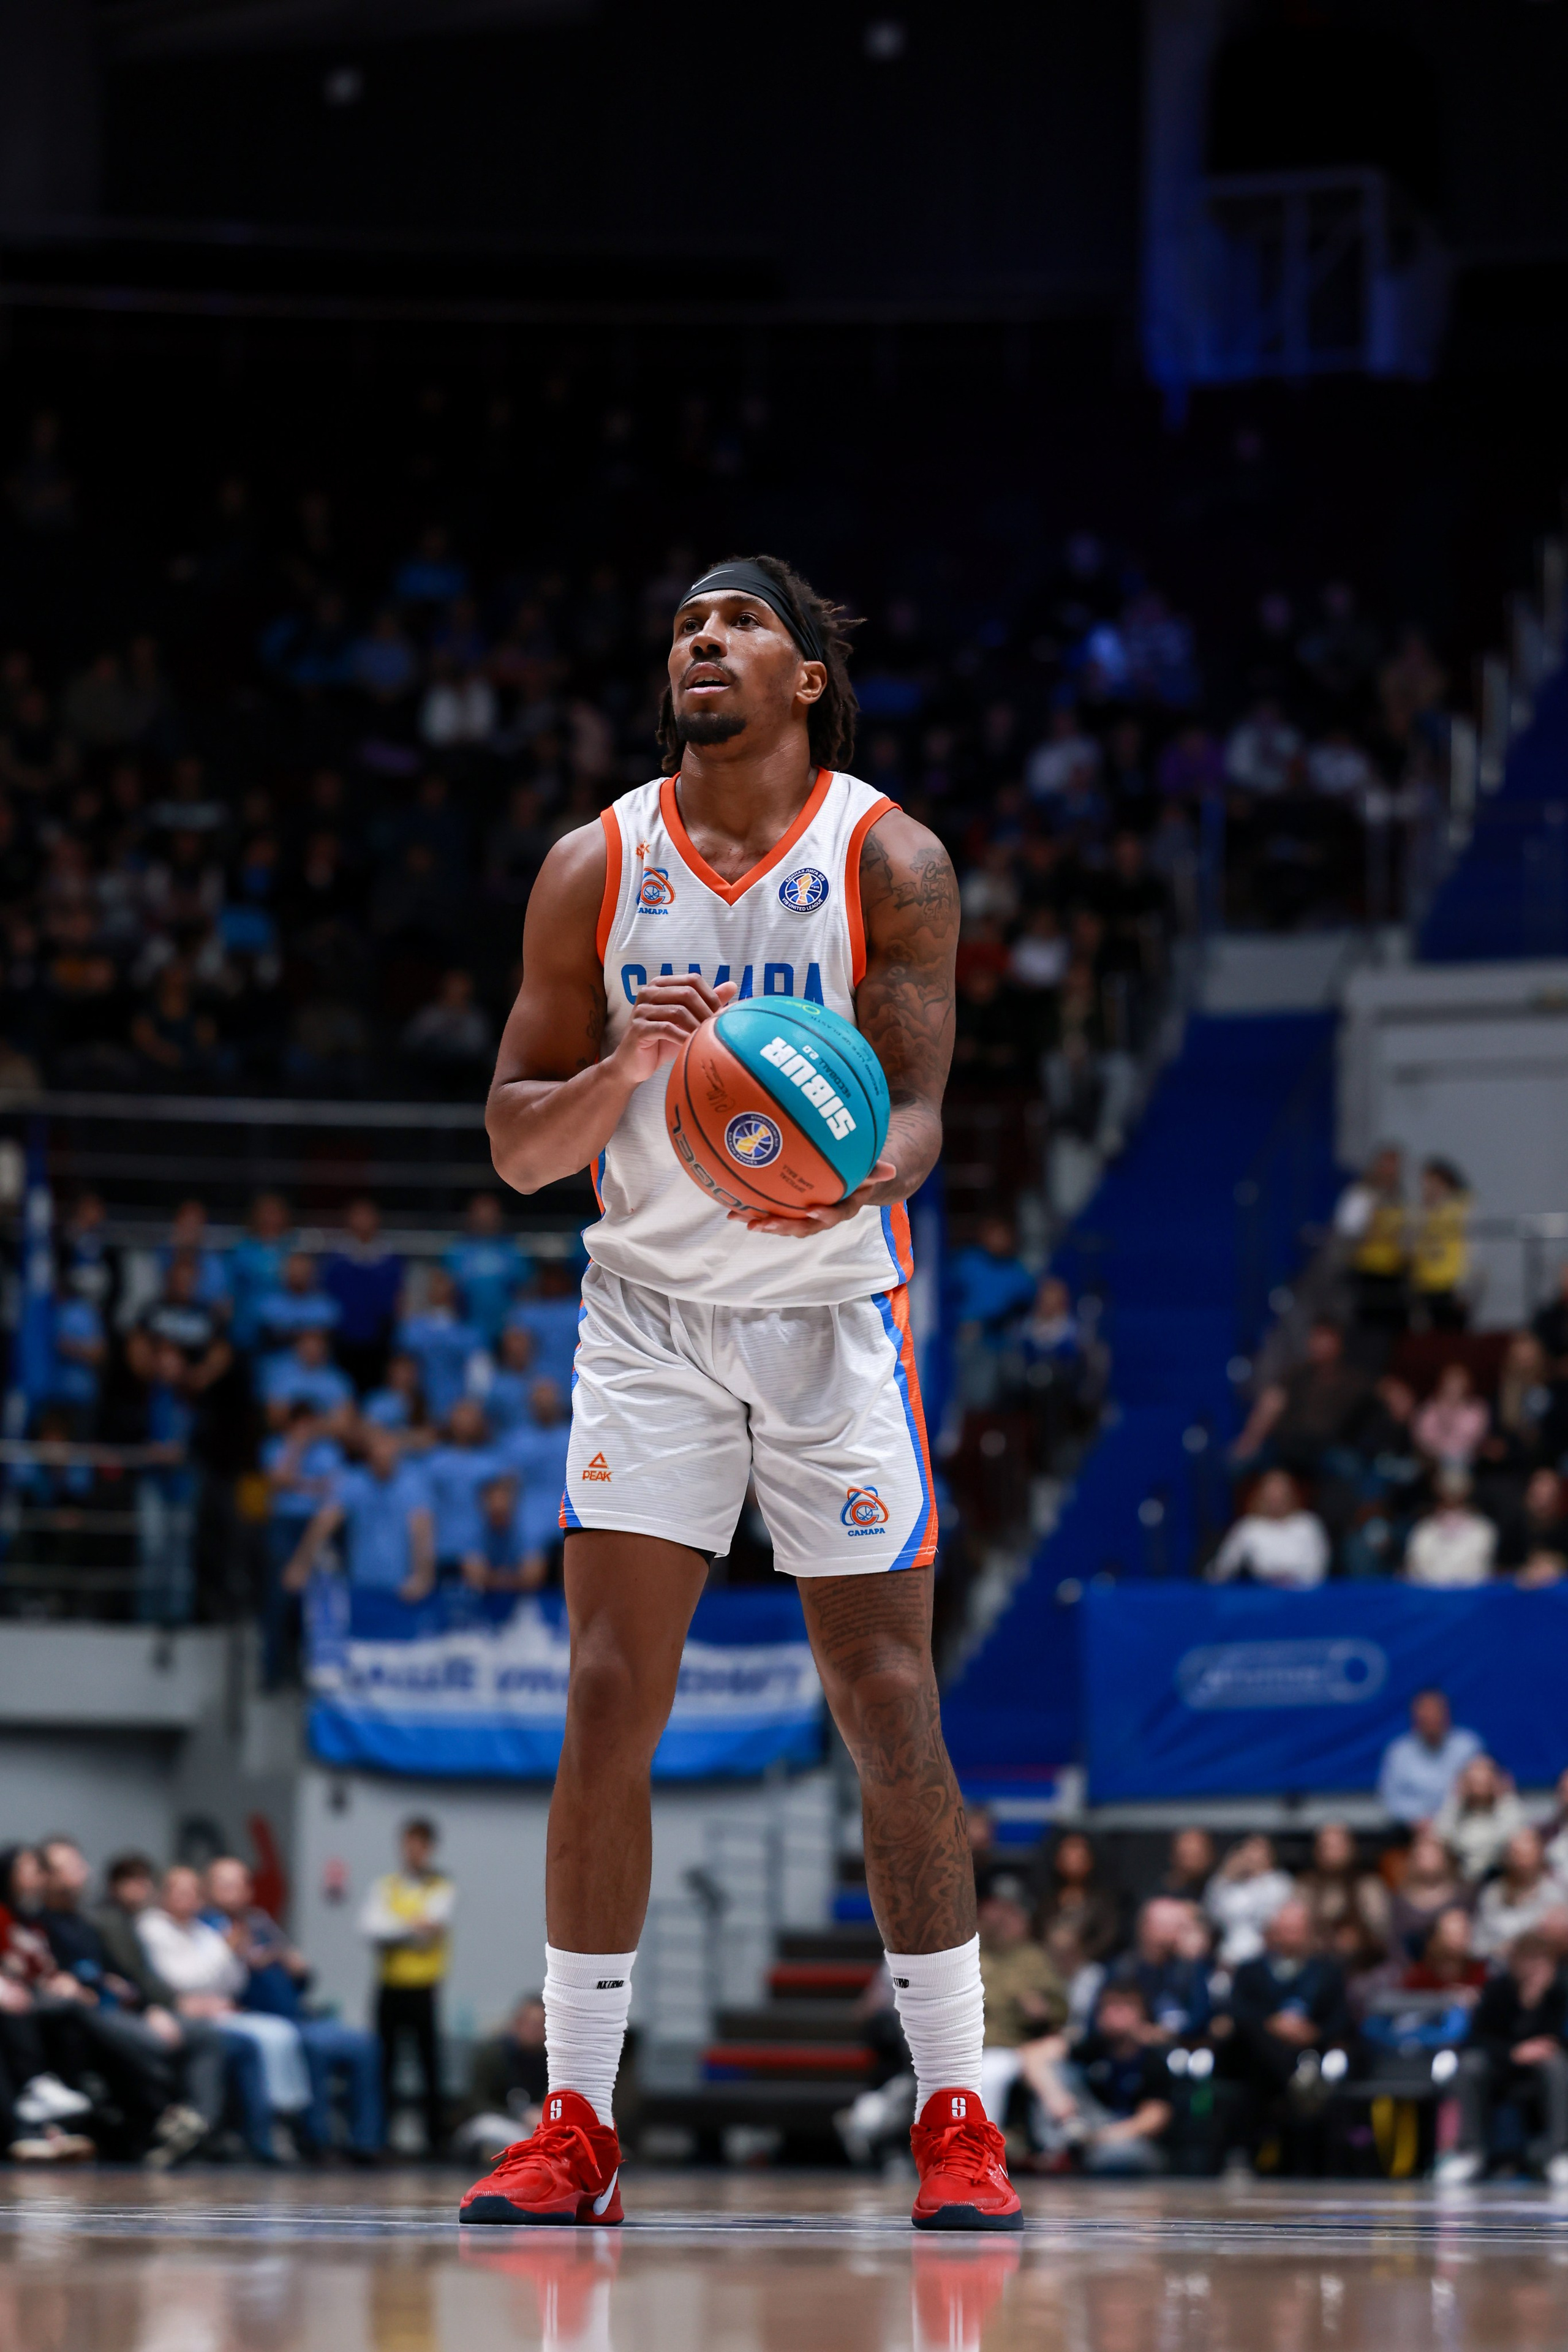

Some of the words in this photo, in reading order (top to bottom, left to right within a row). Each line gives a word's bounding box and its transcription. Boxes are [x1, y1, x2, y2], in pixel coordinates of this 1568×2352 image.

[785, 869, 805, 883] ЕДИНАЯ
[788, 903, 806, 911] UNITED
[807, 898, 823, 910] LEAGUE
[802, 1044, 820, 1060] 2.0
[760, 1036, 857, 1141] SIBUR
[582, 1470, 612, 1482] PEAK
